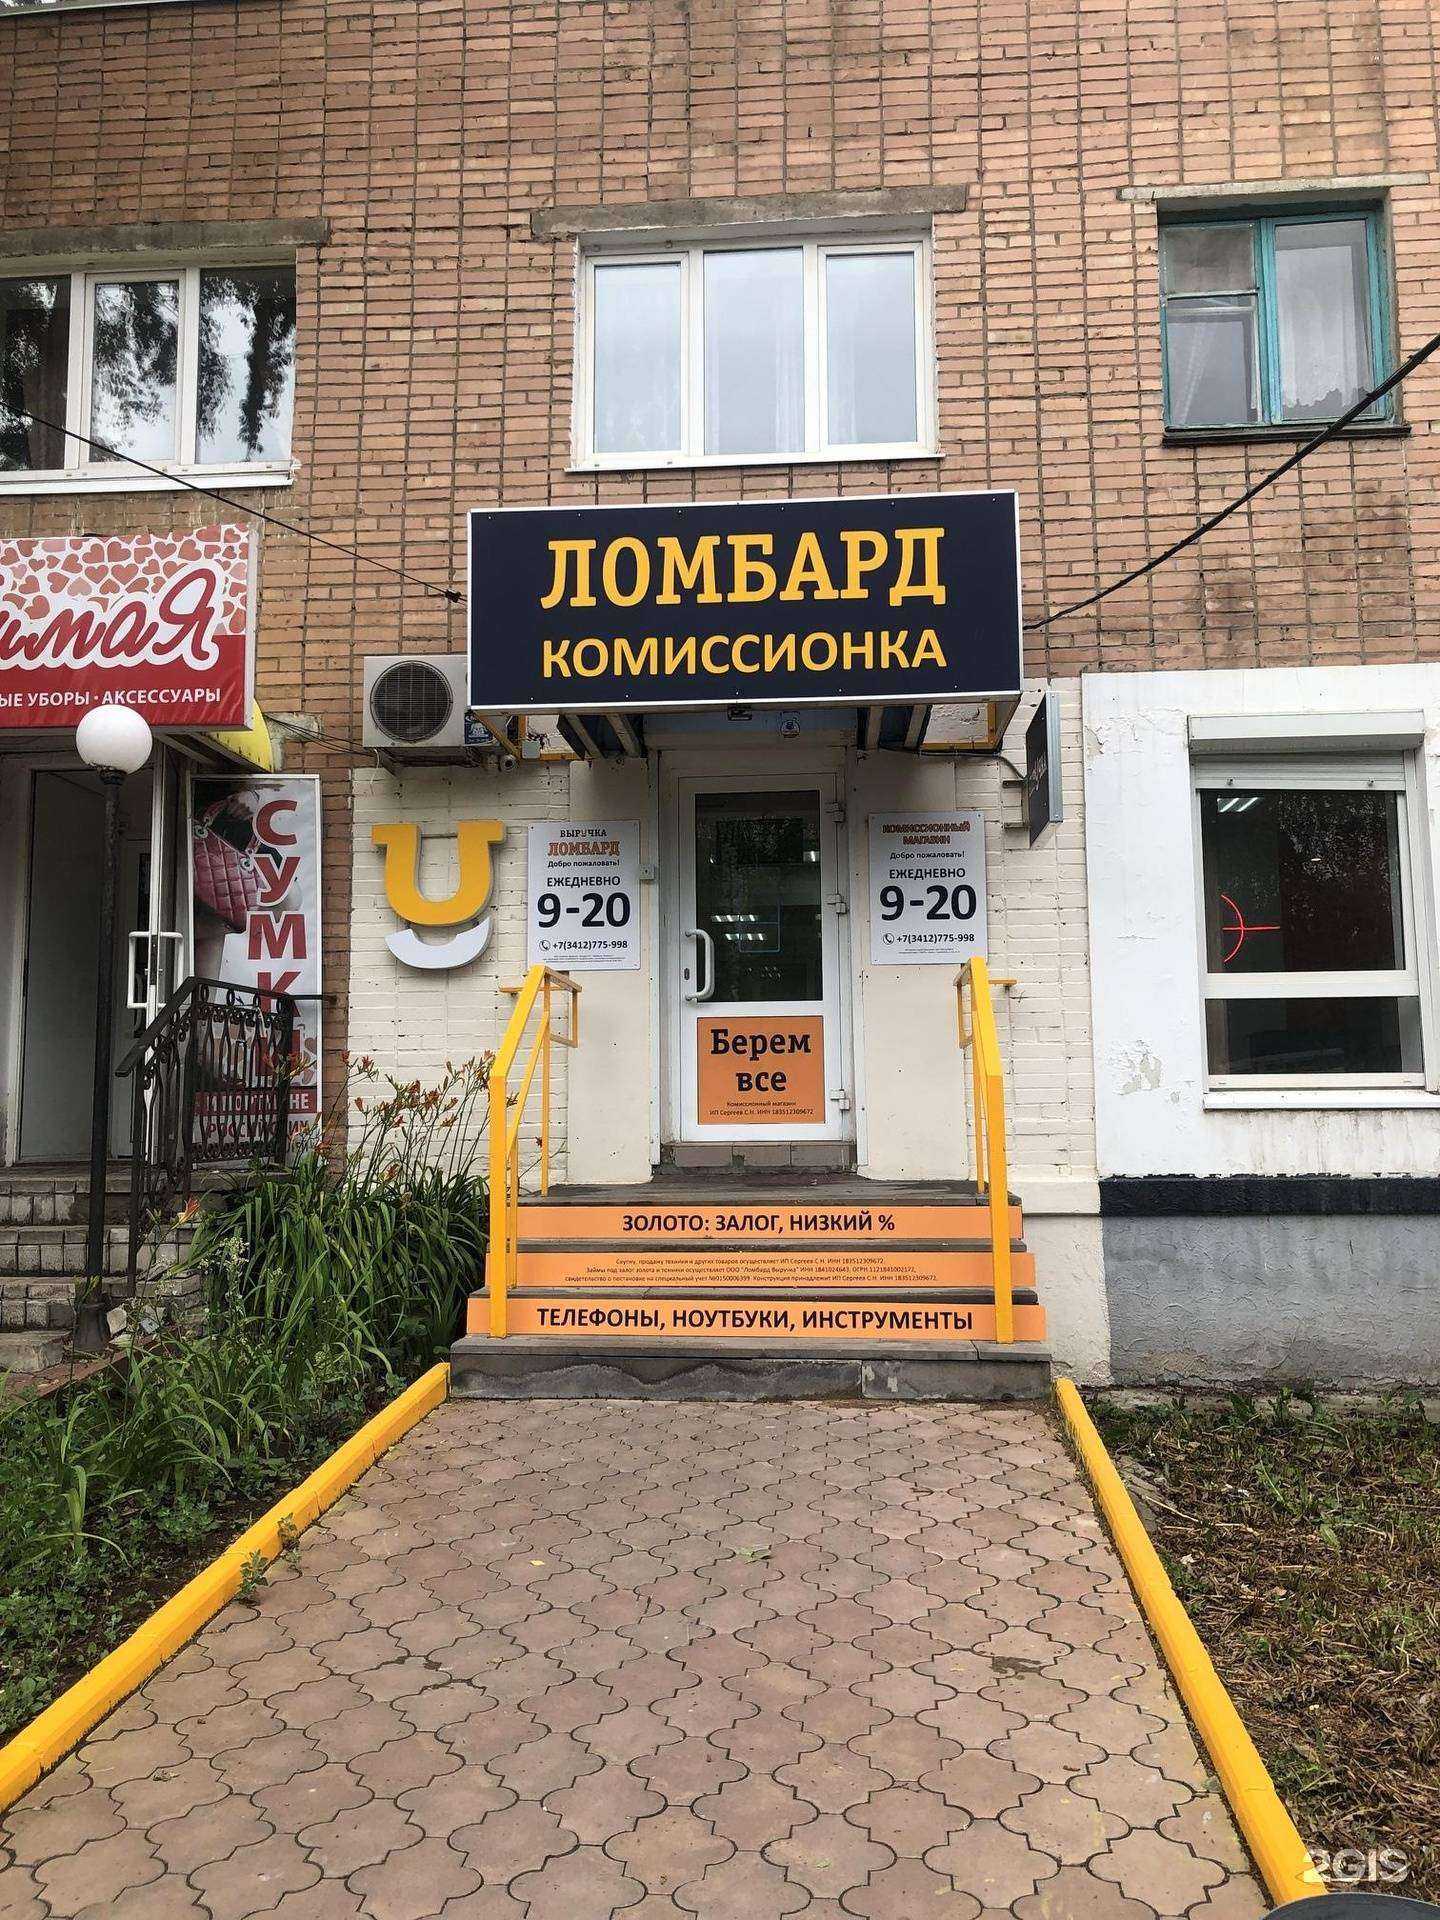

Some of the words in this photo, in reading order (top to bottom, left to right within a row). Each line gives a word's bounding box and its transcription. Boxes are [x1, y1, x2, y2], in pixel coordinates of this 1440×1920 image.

[540, 527, 946, 609] ЛОМБАРД
[542, 628, 947, 679] КОМИССИОНКА
[28, 691, 90, 706] УБОРЫ
[102, 688, 221, 705] АКСЕССУАРЫ
[548, 841, 620, 856] ЛОМБАРД
[903, 835, 951, 845] МАГАЗИН
[548, 860, 572, 868] Добро
[573, 859, 620, 867] пожаловать!
[890, 851, 915, 860] Добро
[916, 850, 965, 859] пожаловать!
[547, 875, 621, 888] ЕЖЕДНЕВНО
[889, 867, 966, 880] ЕЖЕДНЕВНО
[537, 892, 630, 928] 9-20
[880, 884, 976, 921] 9-20
[553, 940, 628, 950] +7(3412)775-998
[896, 934, 975, 944] +7(3412)775-998
[710, 1028, 812, 1061] Берем
[735, 1071, 787, 1091] все
[622, 1214, 710, 1232] ЗОЛОТО:
[715, 1213, 784, 1235] ЗАЛОГ,
[789, 1210, 874, 1232] НИЗКИЙ
[878, 1214, 895, 1232] %
[537, 1307, 666, 1331] ТЕЛЕФОНЫ,
[672, 1309, 795, 1333] НОУТБУКИ,
[803, 1309, 974, 1331] ИНСТРУМЕНТЫ
